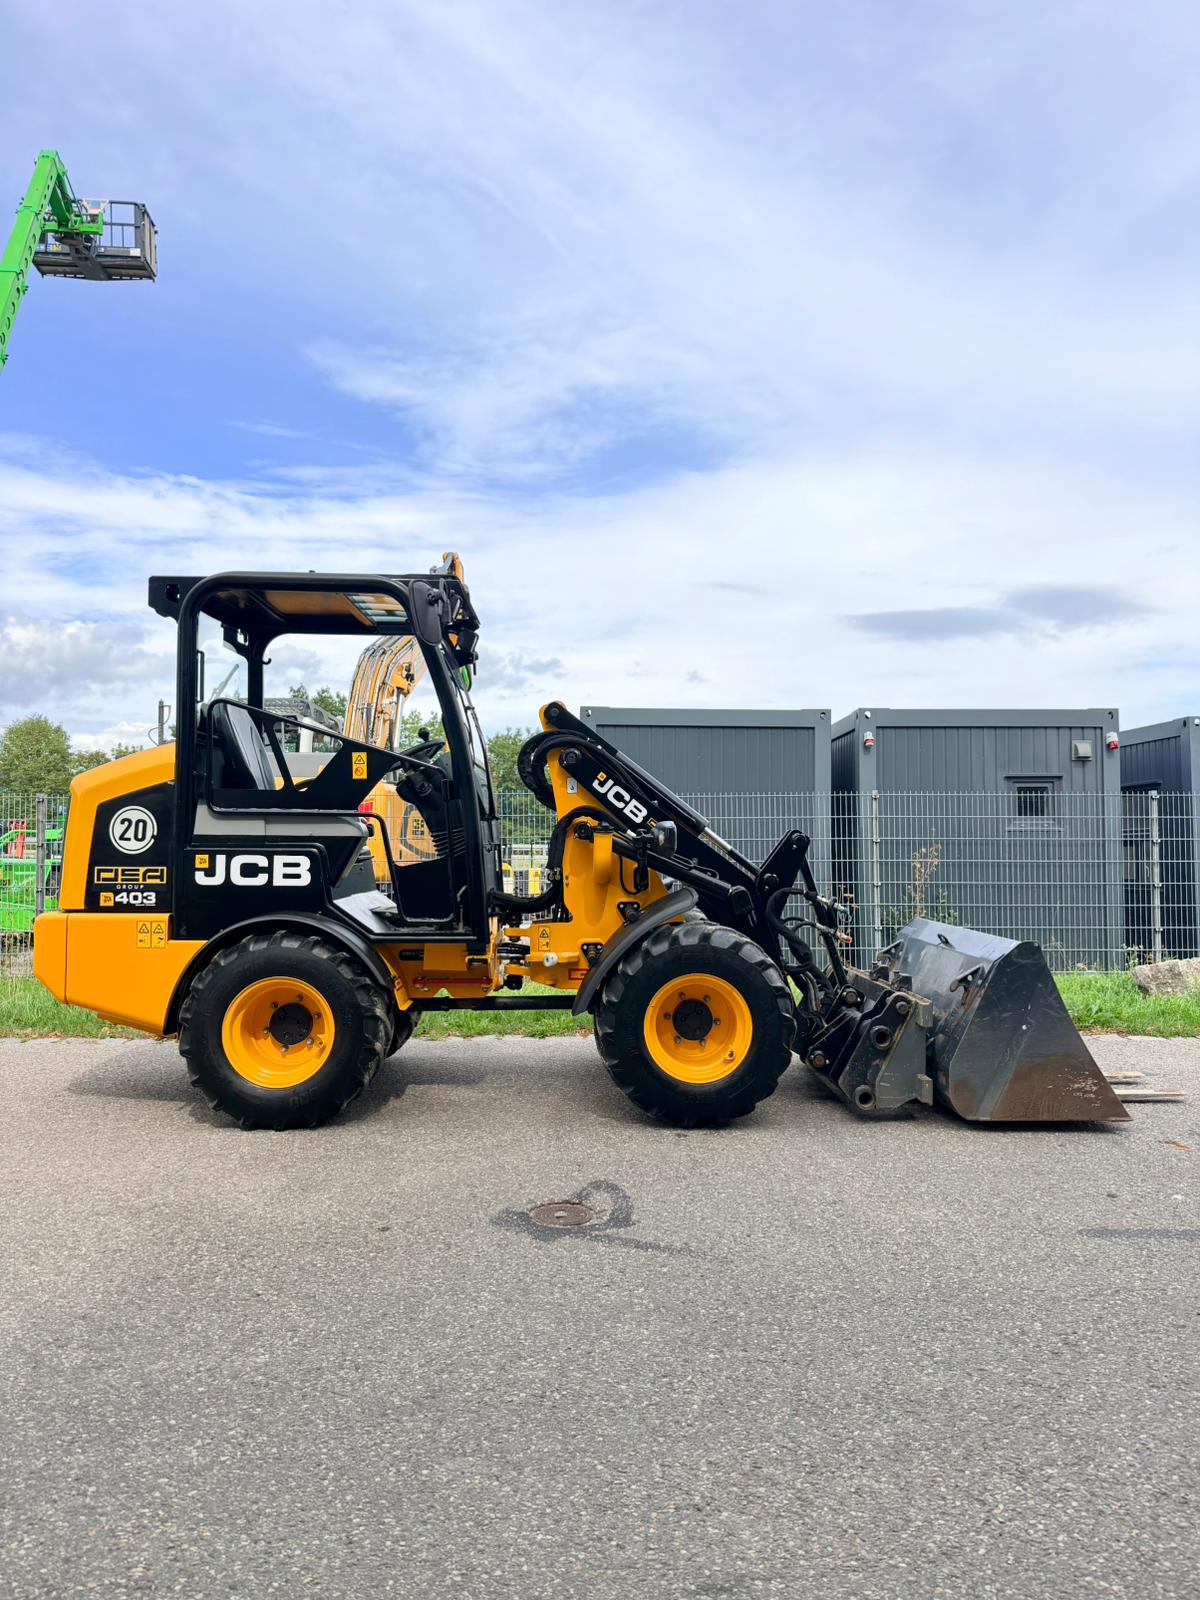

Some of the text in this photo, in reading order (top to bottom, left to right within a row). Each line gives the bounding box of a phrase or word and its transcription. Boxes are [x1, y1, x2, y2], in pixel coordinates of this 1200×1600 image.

[592, 778, 648, 824] JCB
[119, 817, 148, 842] 20
[195, 855, 311, 887] JCB
[115, 891, 156, 904] 403
